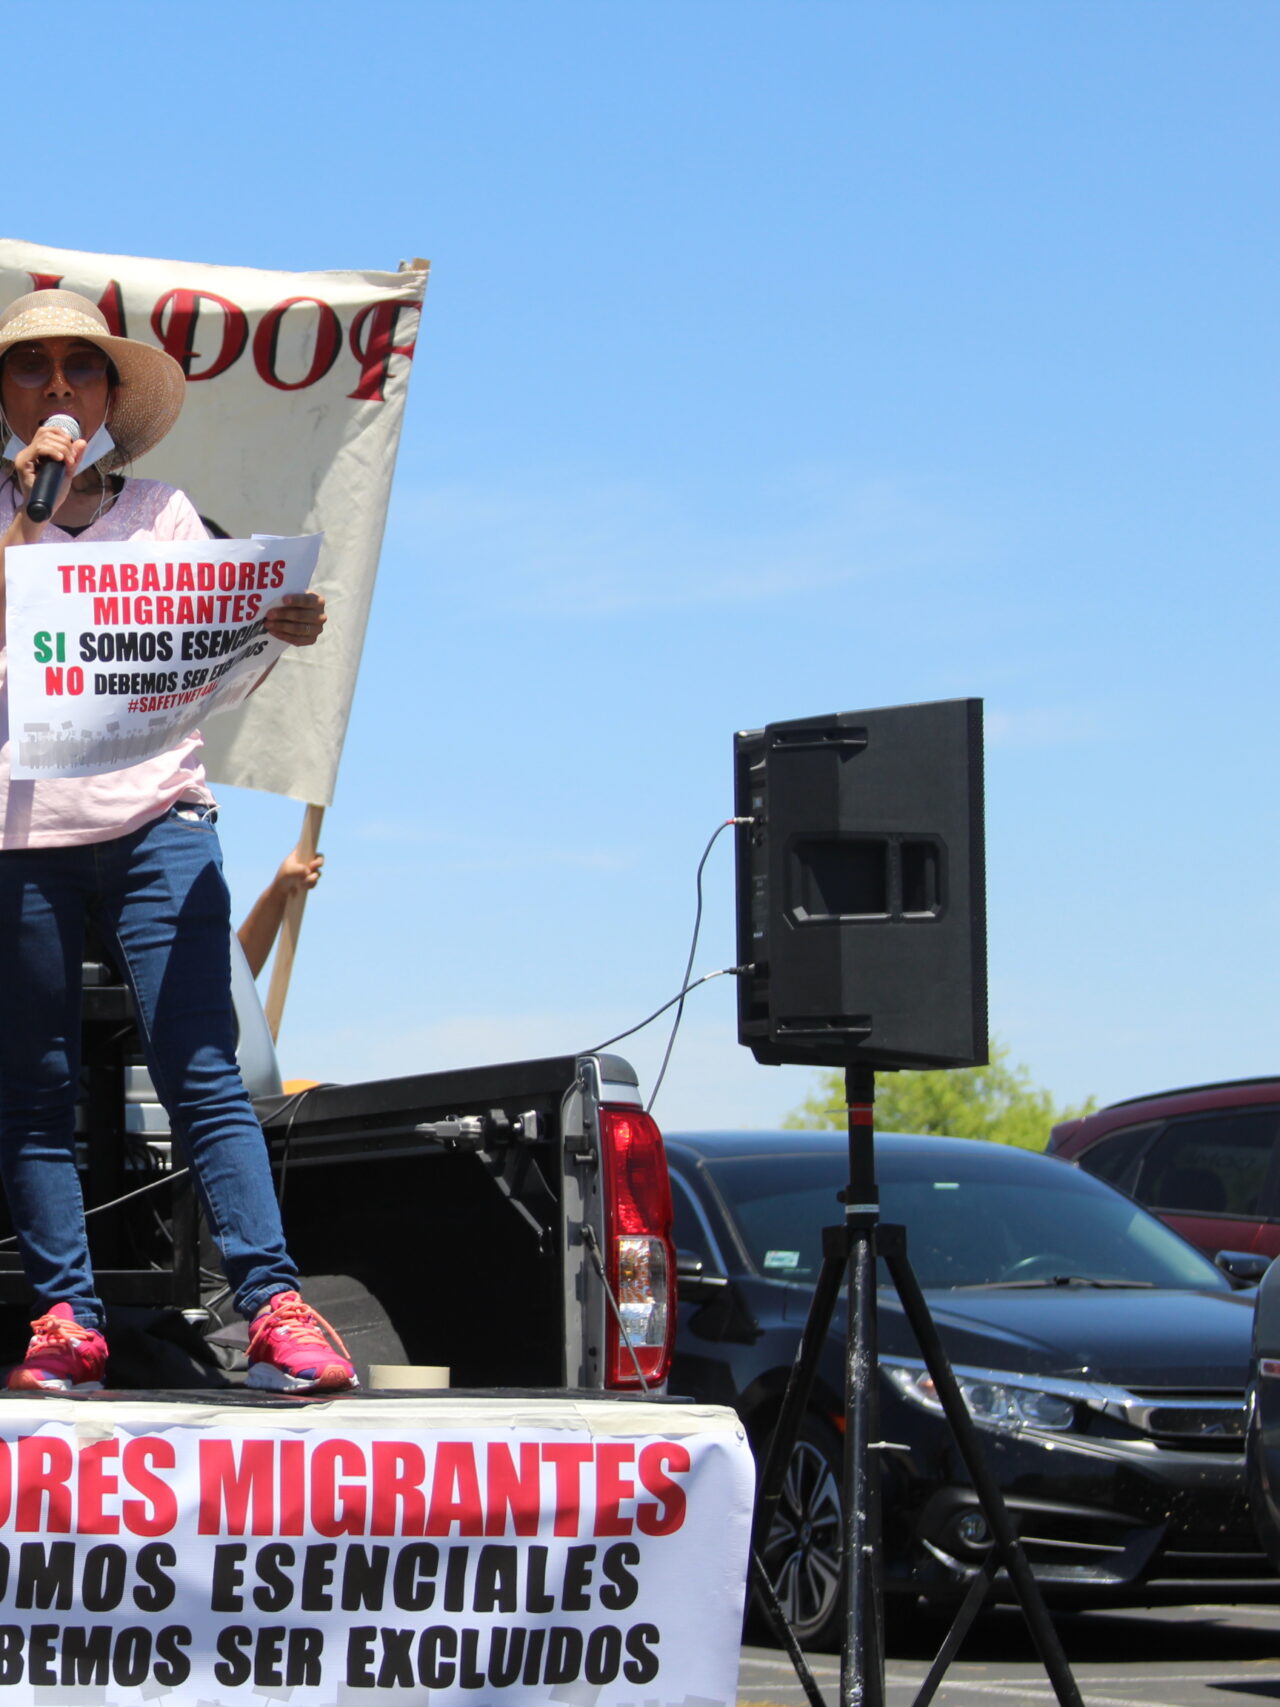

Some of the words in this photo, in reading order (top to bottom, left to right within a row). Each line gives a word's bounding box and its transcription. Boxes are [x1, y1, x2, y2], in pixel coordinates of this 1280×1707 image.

[57, 560, 286, 593] TRABAJADORES
[93, 593, 263, 625] MIGRANTES
[33, 631, 66, 663] SI
[79, 631, 173, 662] SOMOS
[45, 666, 84, 696] NO
[94, 671, 178, 695] DEBEMOS
[181, 668, 210, 691] SER
[197, 1438, 691, 1538] MIGRANTES
[210, 1541, 641, 1613] ESENCIALES
[213, 1625, 325, 1687] SER
[346, 1622, 661, 1689] EXCLUIDOS
